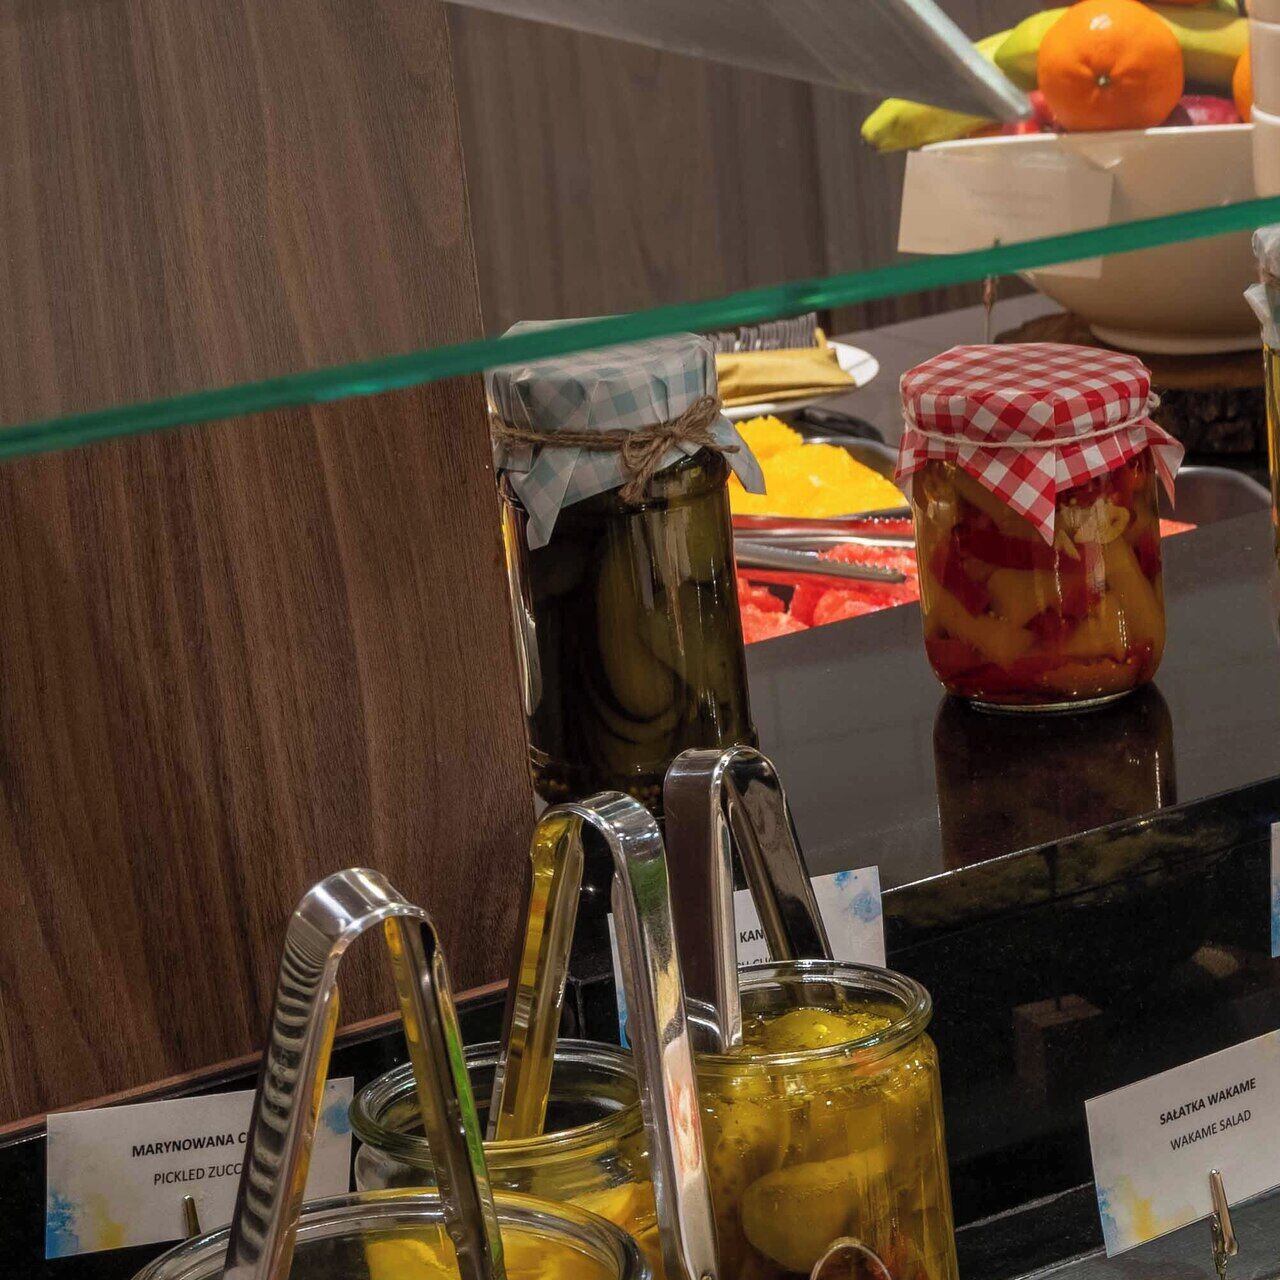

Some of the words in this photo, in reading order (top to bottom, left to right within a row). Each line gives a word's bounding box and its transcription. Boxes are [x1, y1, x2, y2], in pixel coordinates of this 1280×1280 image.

[1159, 1098, 1206, 1126] SAŁATKA
[1206, 1077, 1257, 1106] WAKAME
[132, 1134, 235, 1158] MARYNOWANA
[1169, 1122, 1218, 1151] WAKAME
[1219, 1109, 1251, 1132] SALAD
[153, 1167, 205, 1185] PICKLED
